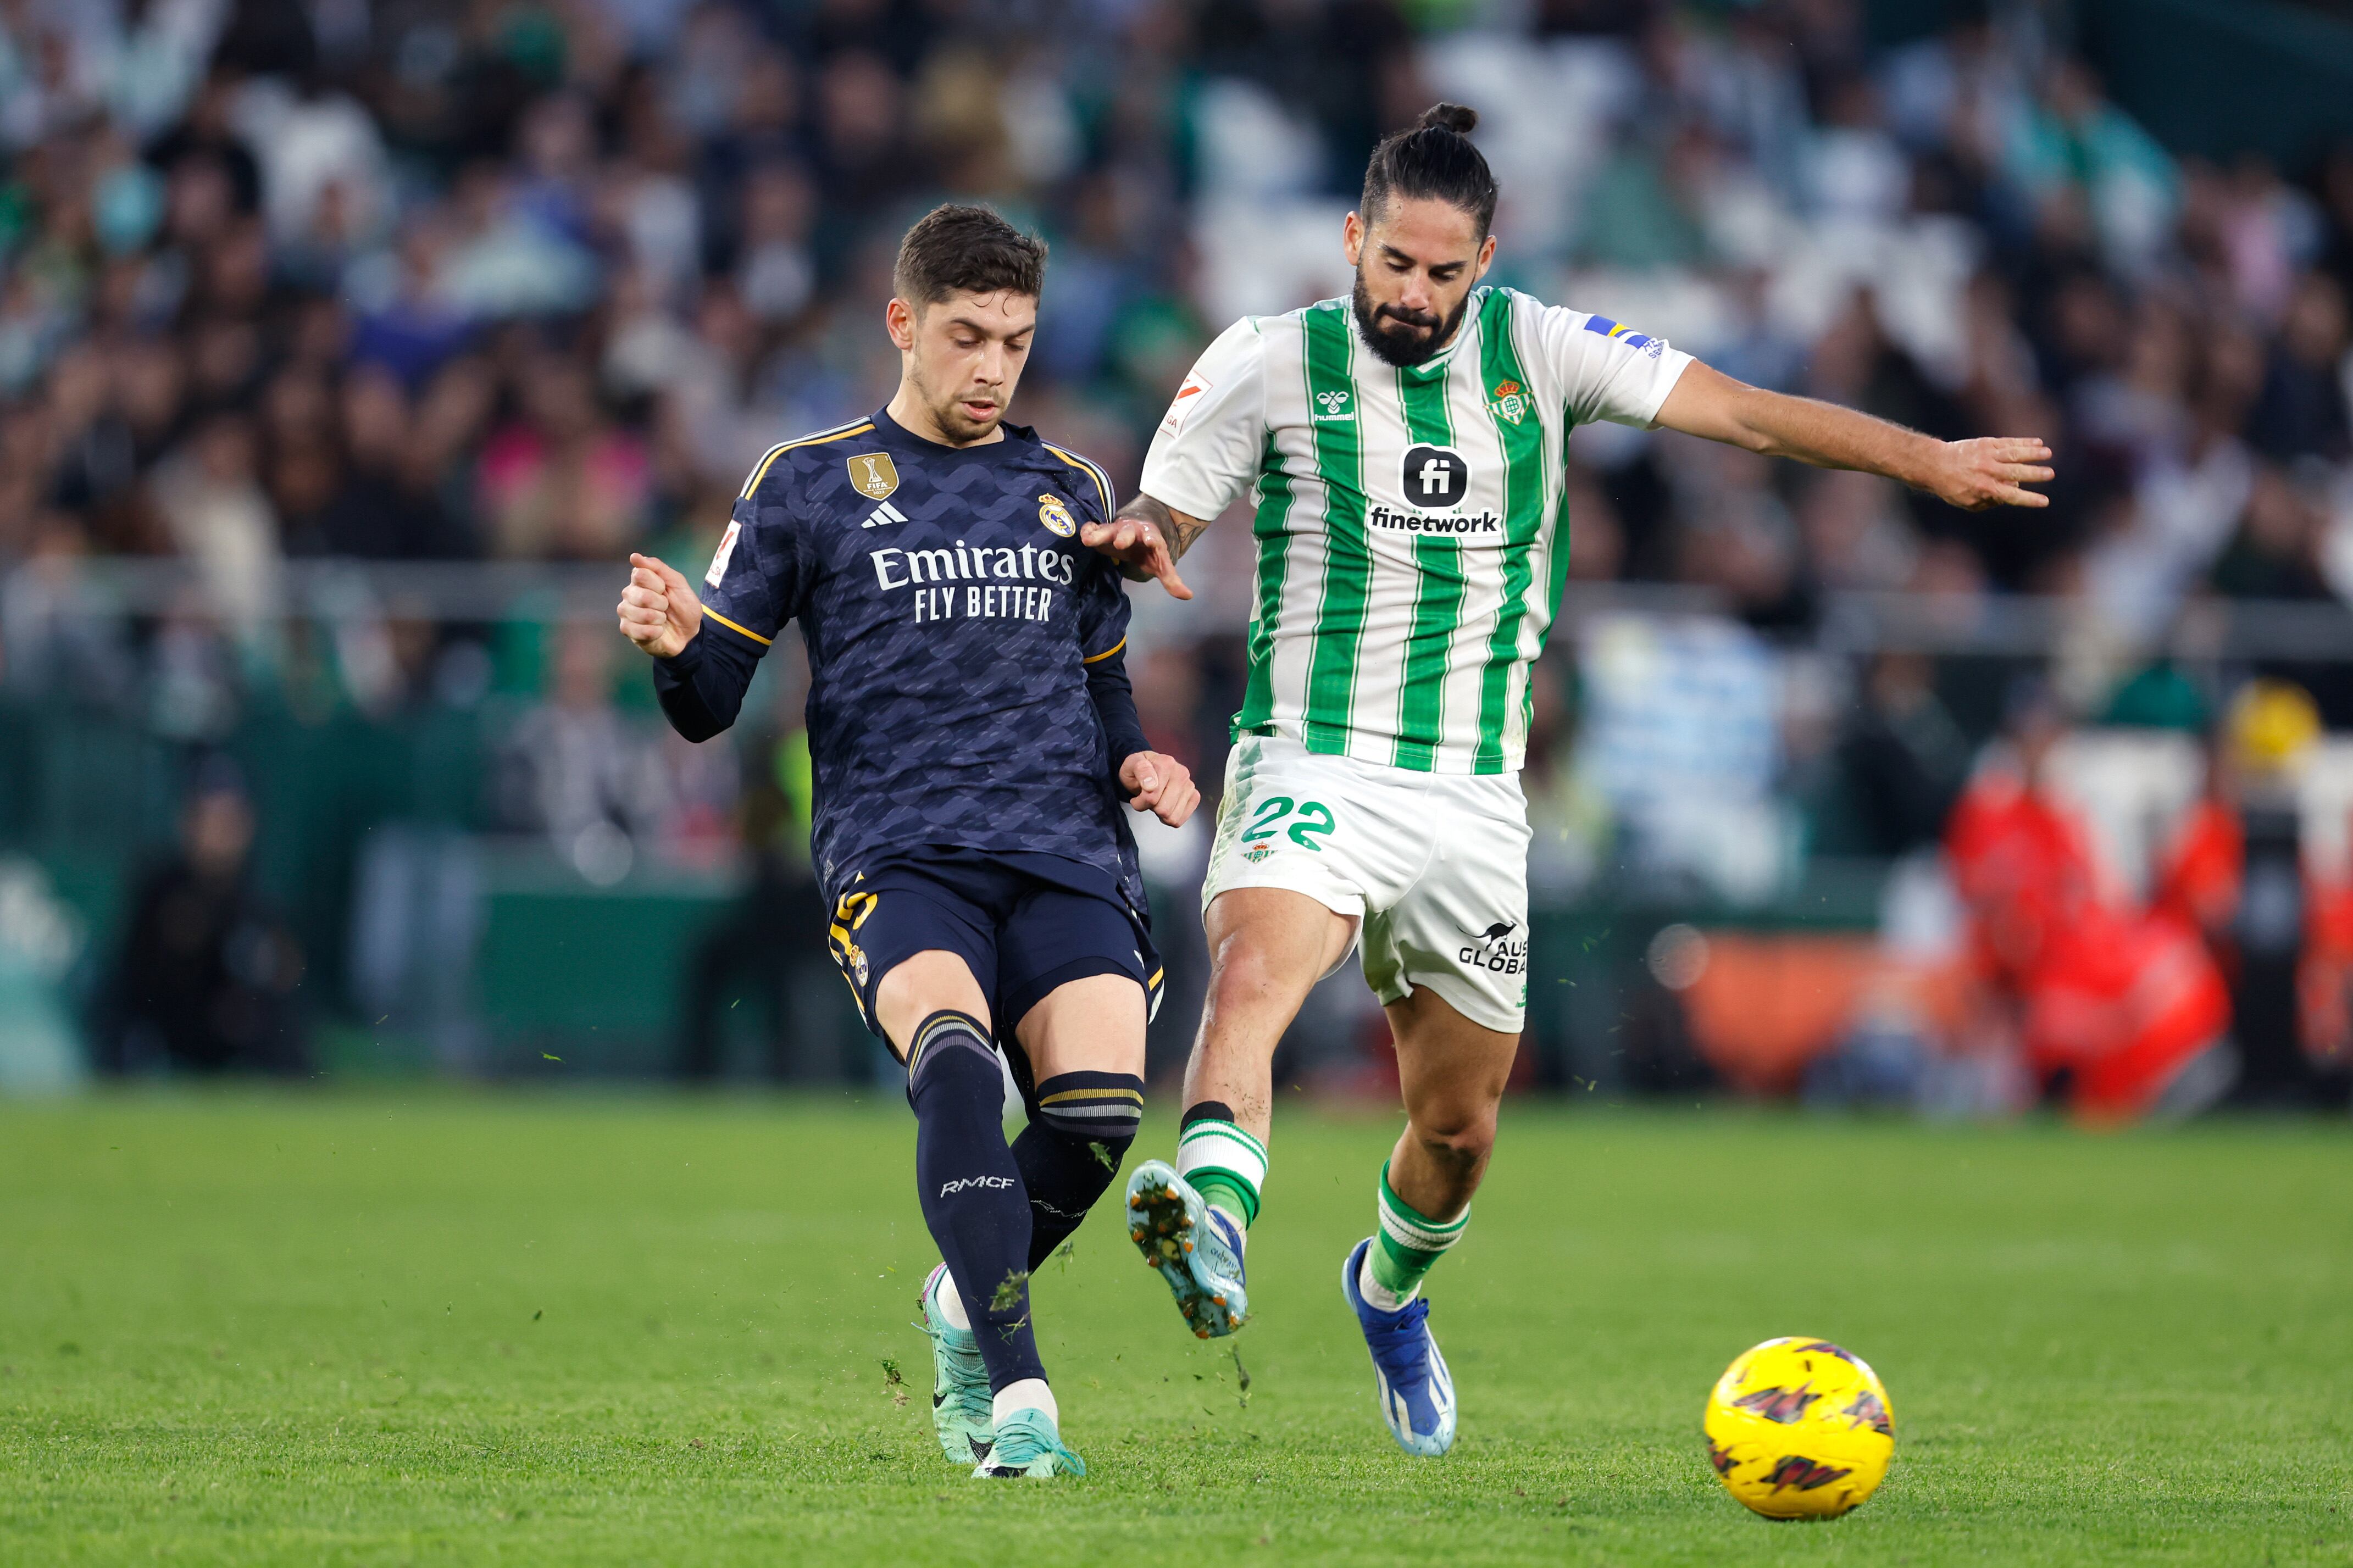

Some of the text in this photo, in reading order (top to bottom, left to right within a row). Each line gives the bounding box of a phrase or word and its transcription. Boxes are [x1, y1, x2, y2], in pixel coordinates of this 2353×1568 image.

[1314, 412, 1355, 421] hummel
[867, 481, 888, 490] FIFA
[1419, 458, 1451, 494] fi
[1371, 507, 1499, 533] finetwork
[869, 540, 1074, 591] Emirates
[915, 585, 1052, 624] FLY BETTER
[1240, 797, 1336, 852] 22
[940, 1175, 1015, 1198] RMCF
